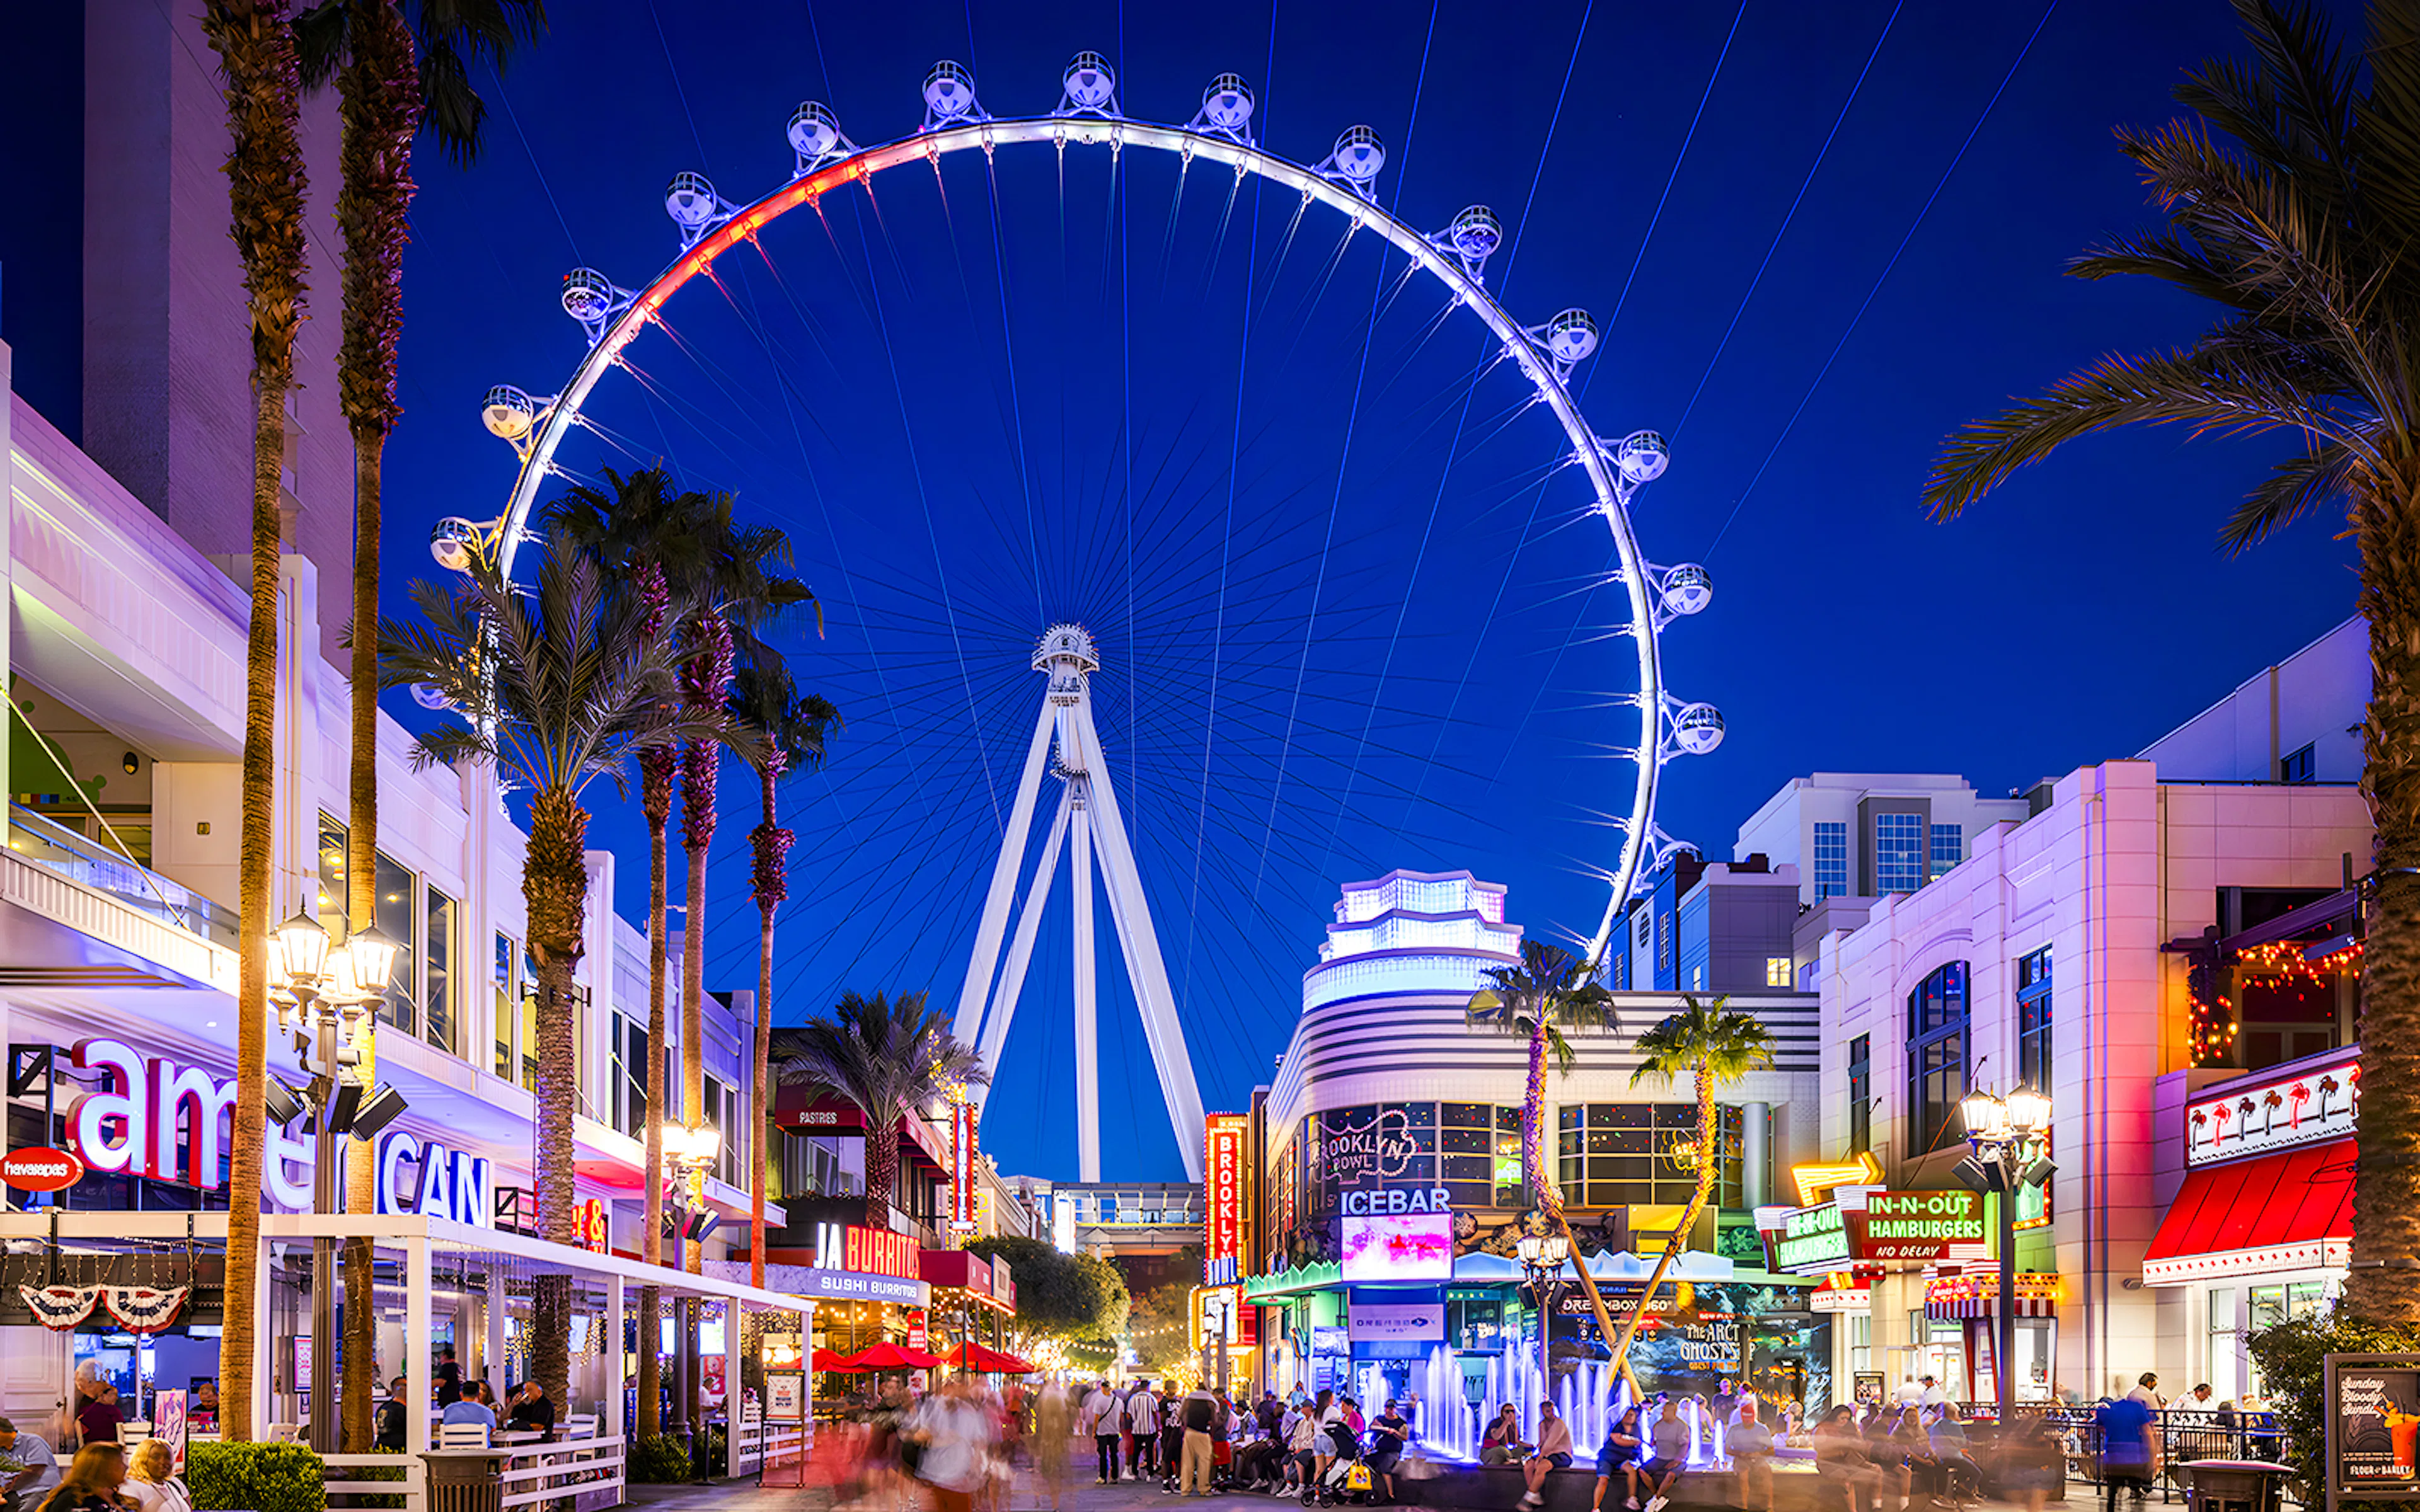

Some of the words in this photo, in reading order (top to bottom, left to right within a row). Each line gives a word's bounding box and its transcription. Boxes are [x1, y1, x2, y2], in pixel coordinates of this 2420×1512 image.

[799, 1111, 838, 1124] PASTRIES
[67, 1036, 489, 1228] amerCAN
[1333, 1154, 1373, 1171] BOWL
[1340, 1188, 1451, 1215] ICEBAR
[1868, 1196, 1973, 1215] IN-N-OUT
[1868, 1219, 1983, 1239] HAMBURGERS
[813, 1222, 843, 1271] JA
[846, 1225, 921, 1280] BURRITOS
[1876, 1245, 1896, 1257] NO
[1899, 1245, 1940, 1257] DELAY
[821, 1276, 868, 1292] SUSHI
[870, 1281, 918, 1298] BURRITOS
[1562, 1299, 1639, 1311] DREMBOX
[1705, 1323, 1751, 1342] ARCT
[1680, 1342, 1757, 1361] GHOSTSP
[2340, 1376, 2386, 1393] Sunday
[2340, 1389, 2383, 1406] Bloody
